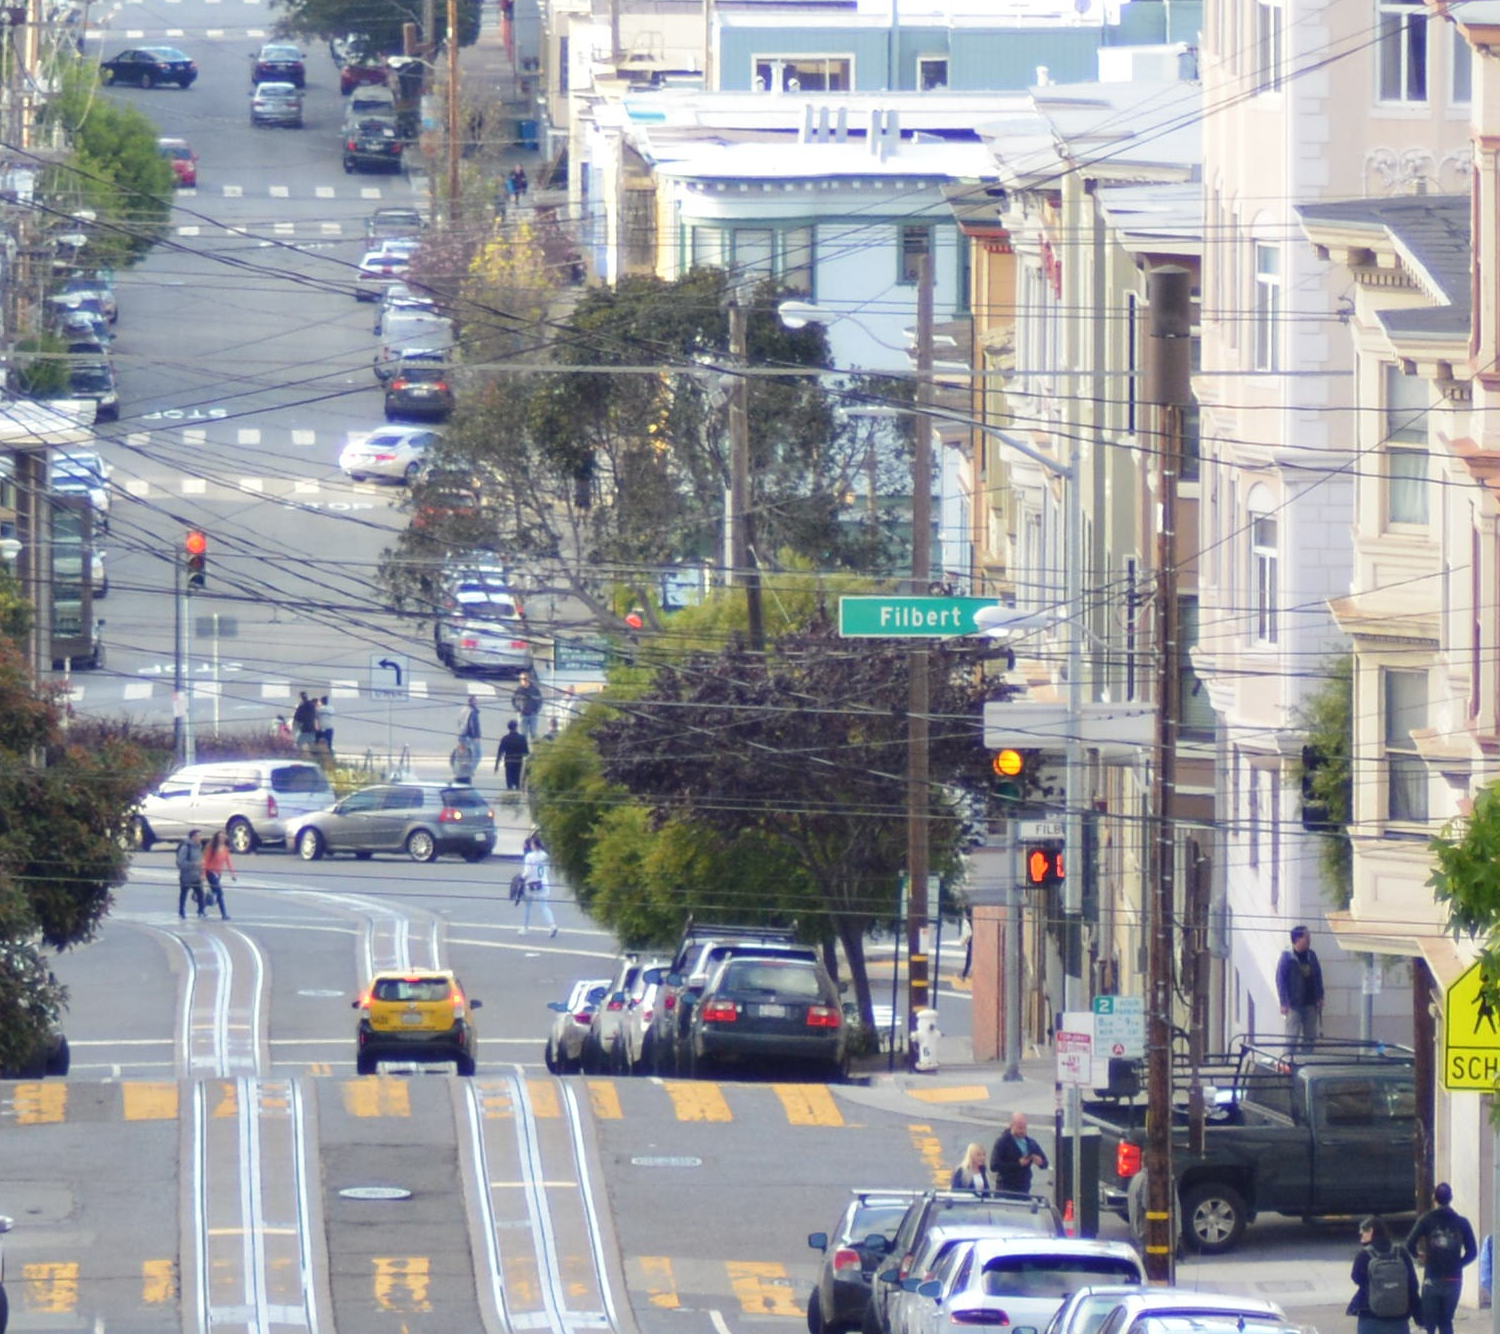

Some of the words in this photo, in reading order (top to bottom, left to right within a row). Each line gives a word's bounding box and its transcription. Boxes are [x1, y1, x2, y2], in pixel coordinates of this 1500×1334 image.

[142, 408, 228, 420] STOP
[879, 606, 962, 627] Filbert
[1099, 999, 1110, 1012] 2
